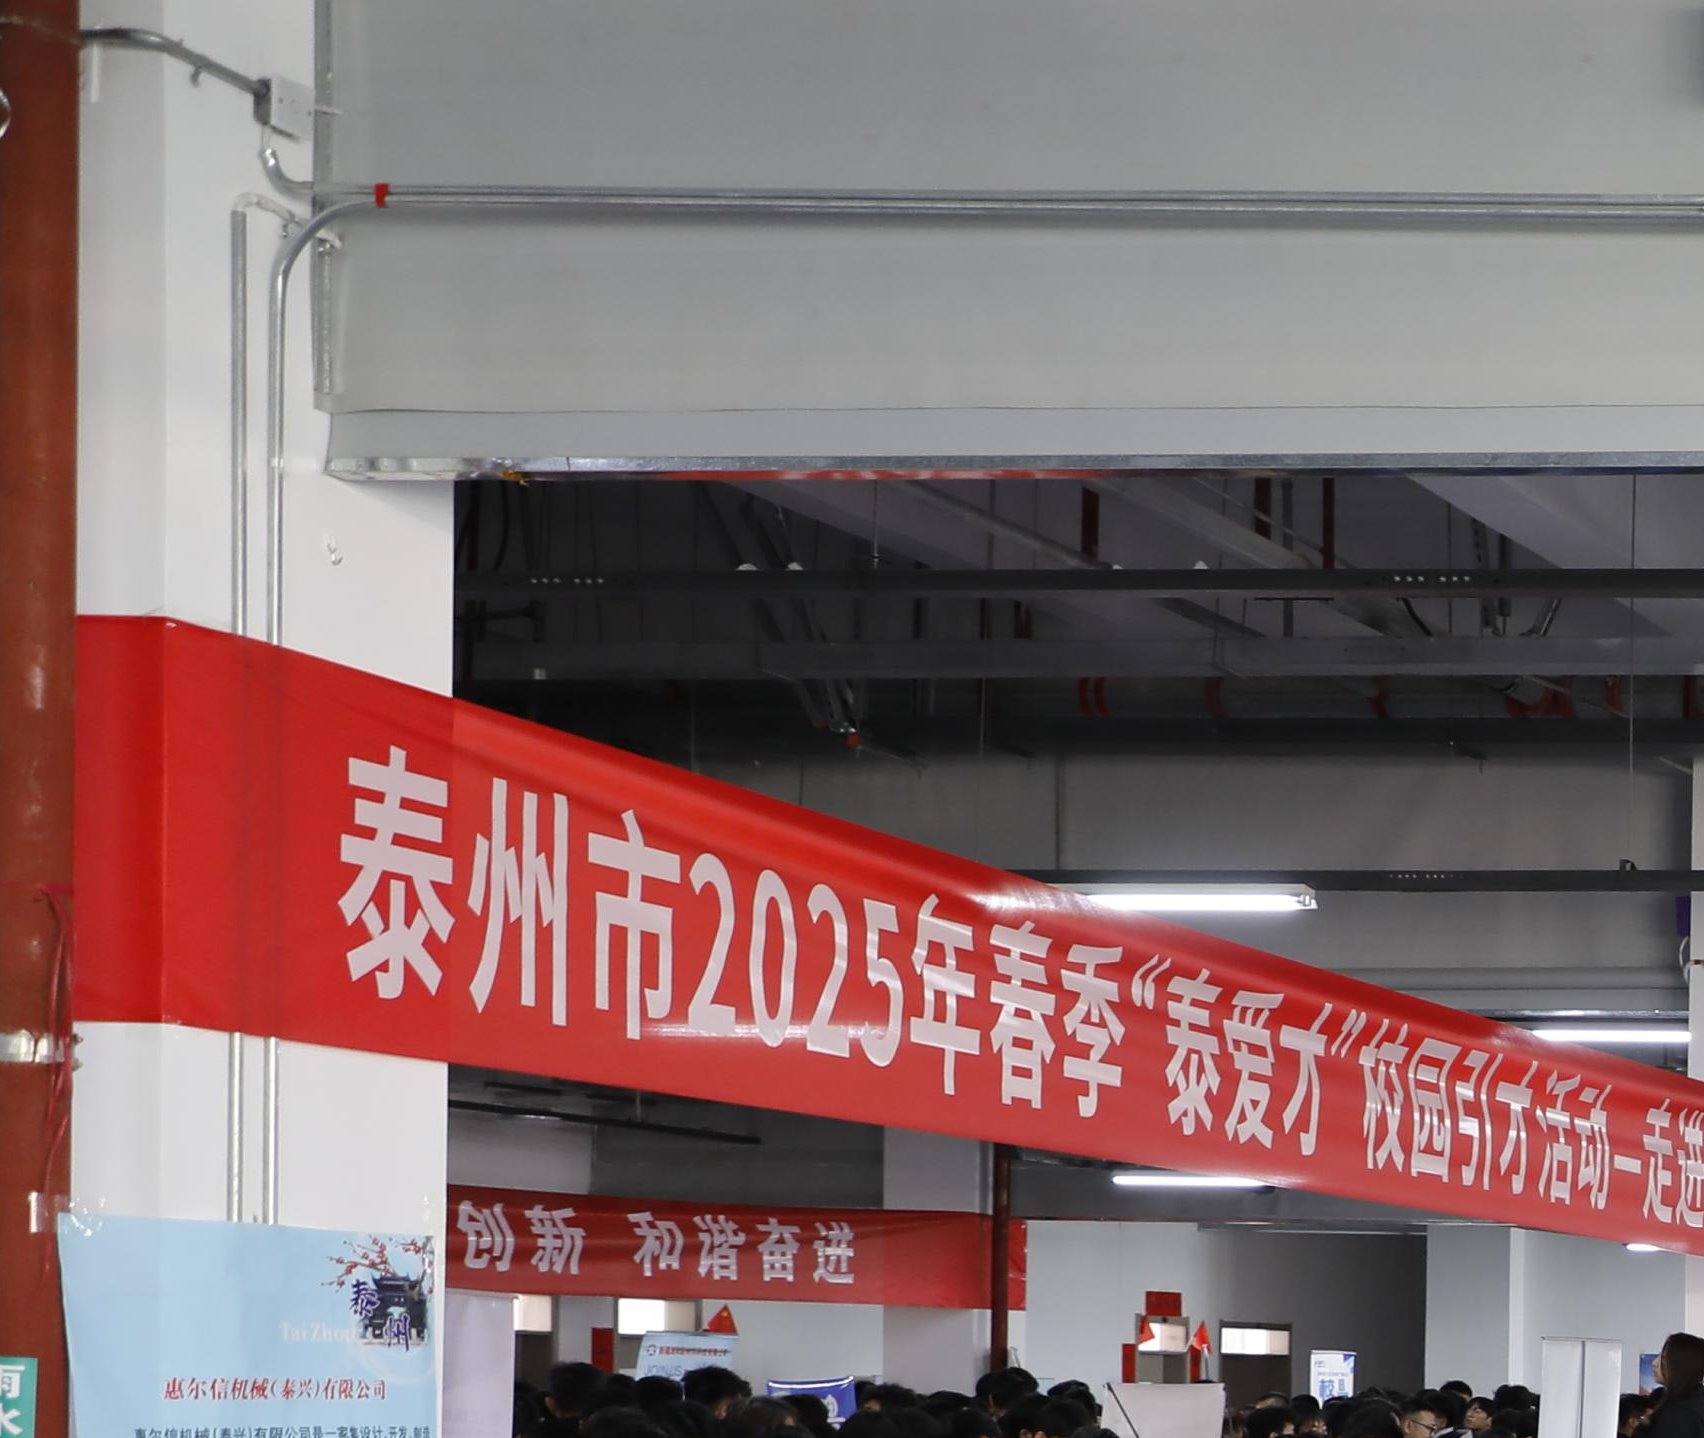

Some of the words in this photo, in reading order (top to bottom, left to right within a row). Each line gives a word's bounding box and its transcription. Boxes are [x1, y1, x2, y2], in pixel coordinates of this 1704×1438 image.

[456, 1199, 586, 1276] 创新
[626, 1211, 856, 1285] 和谐奋进
[163, 1376, 388, 1400] 惠尔信机械（泰兴）有限公司
